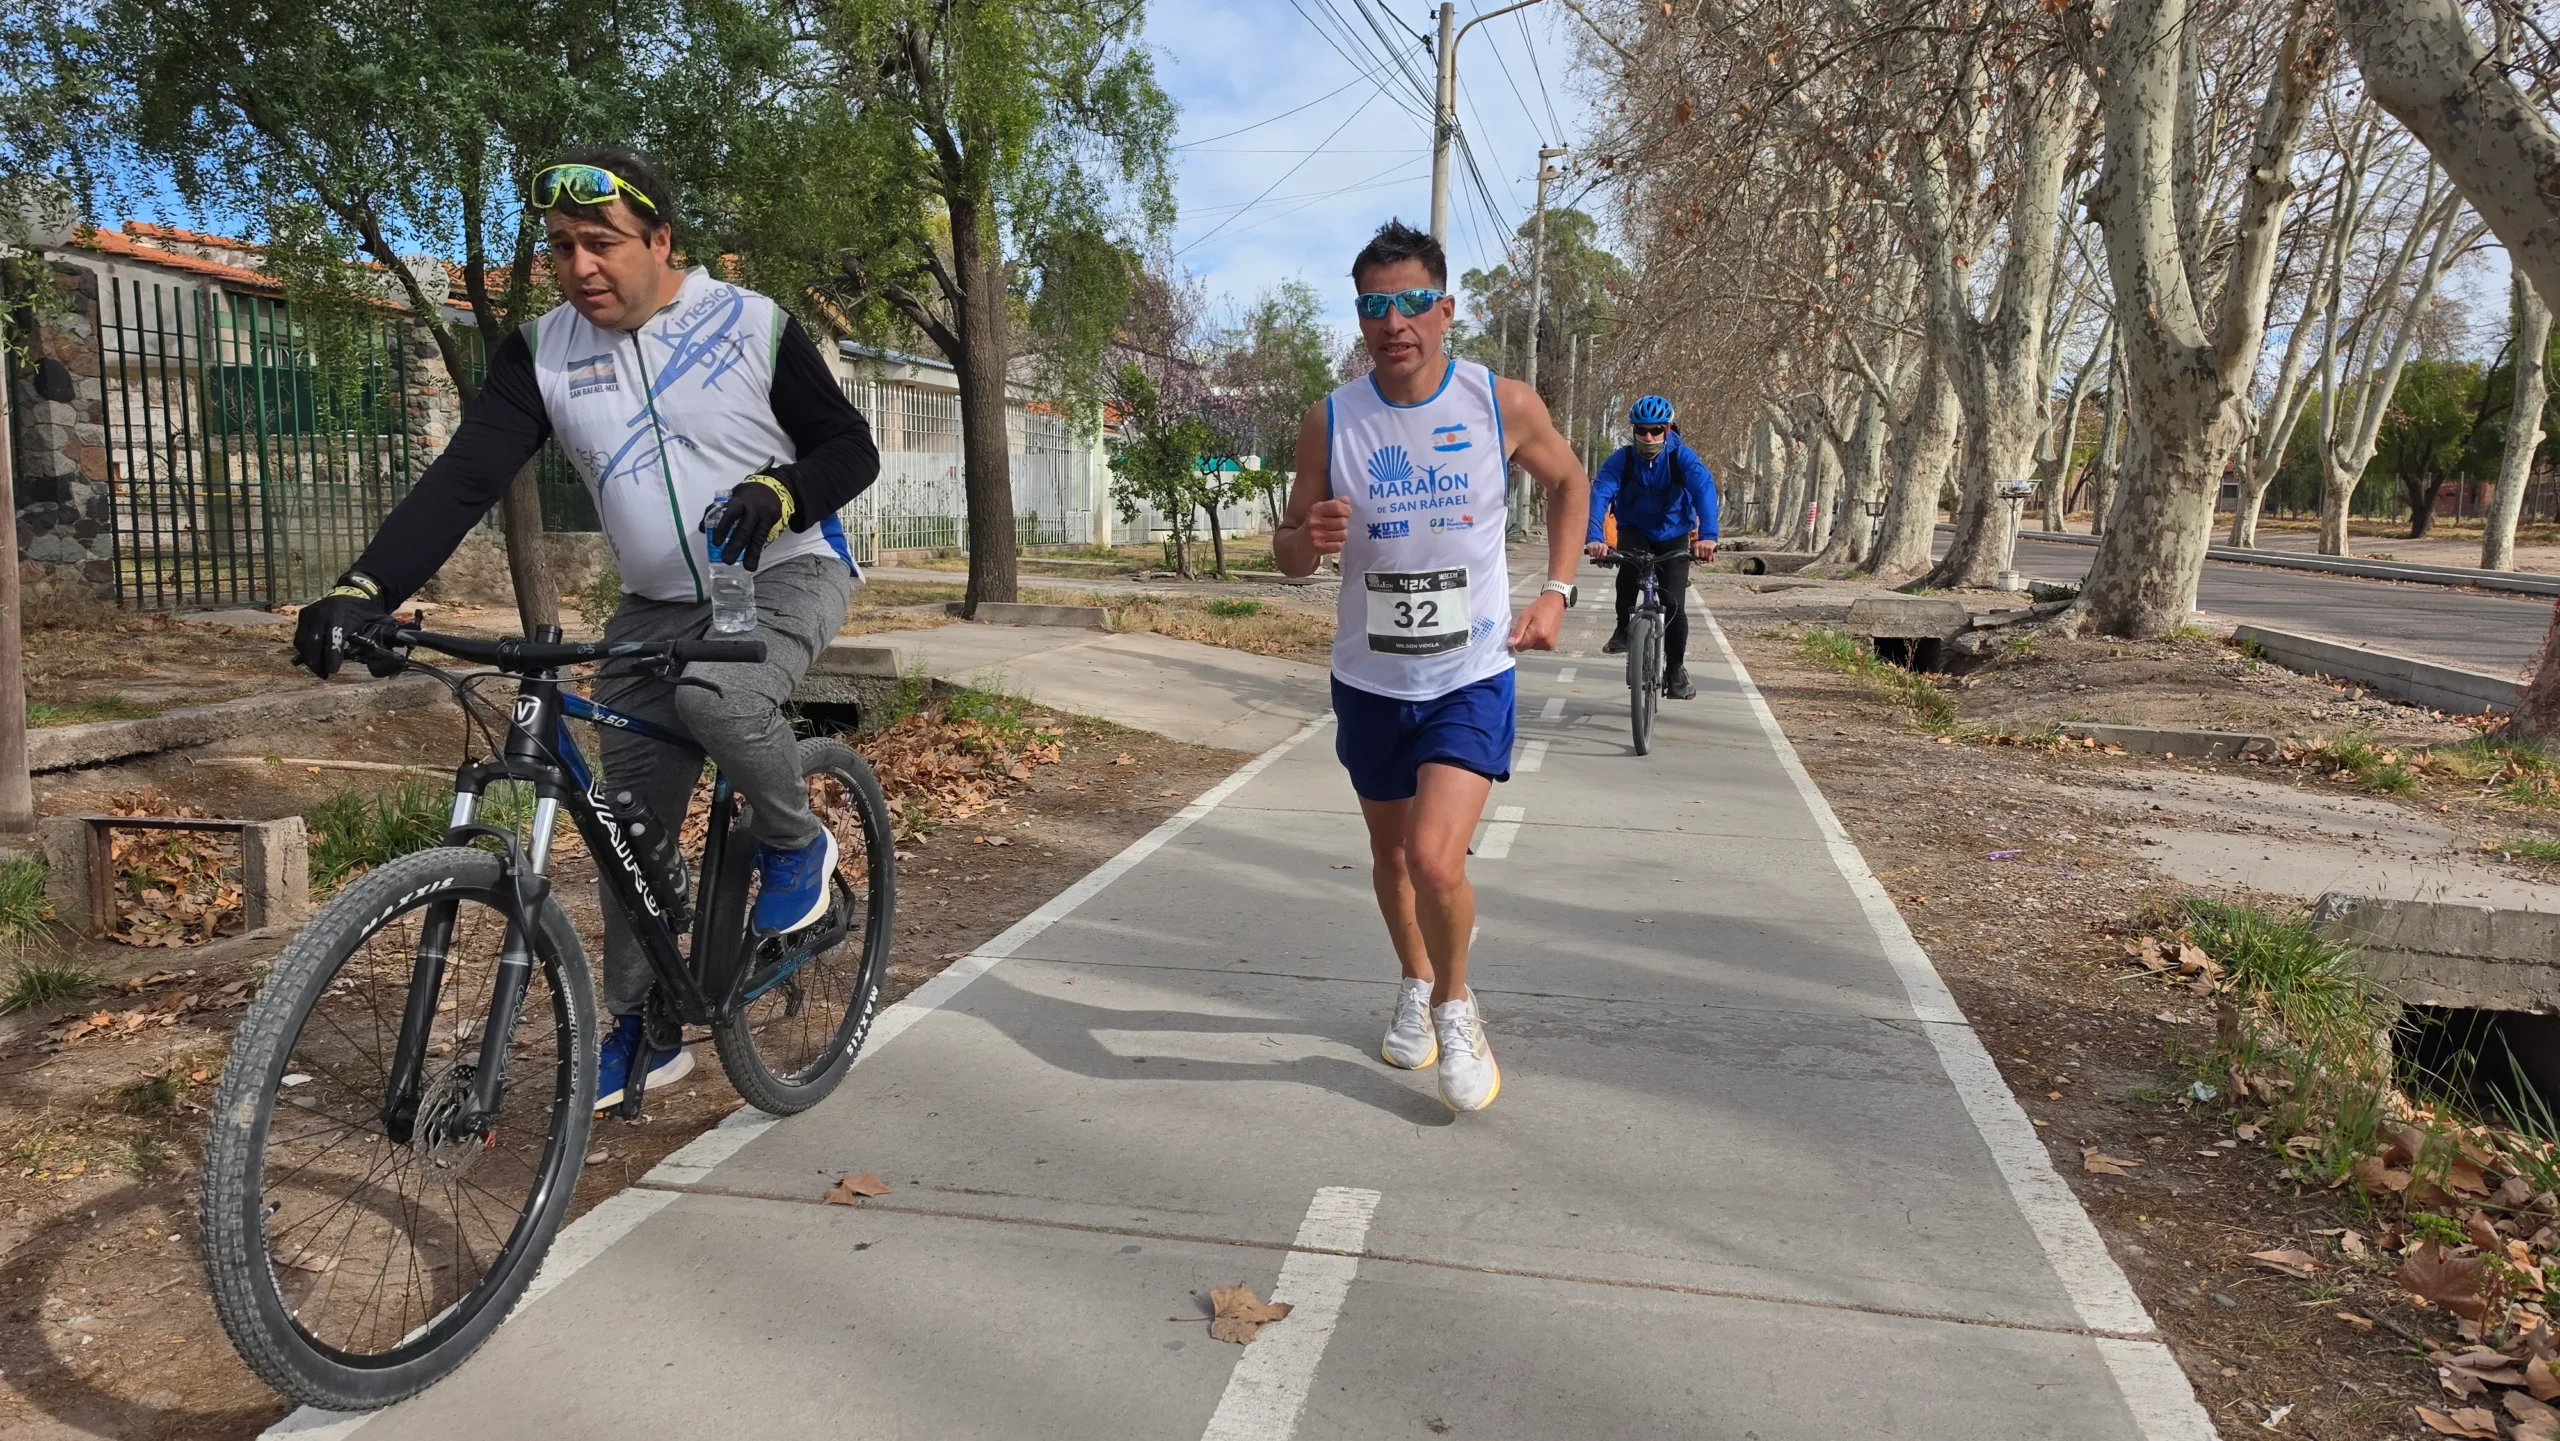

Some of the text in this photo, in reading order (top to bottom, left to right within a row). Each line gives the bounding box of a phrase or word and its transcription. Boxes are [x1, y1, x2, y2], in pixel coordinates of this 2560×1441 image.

[652, 288, 728, 349] Kinesio
[569, 389, 581, 399] SAN
[1369, 464, 1469, 500] MARATON
[1377, 494, 1469, 514] DE SAN RAFAEL
[1381, 520, 1410, 532] UTN
[1399, 578, 1432, 590] 42K
[1393, 600, 1439, 629] 32
[846, 984, 879, 1056] MAXXIS
